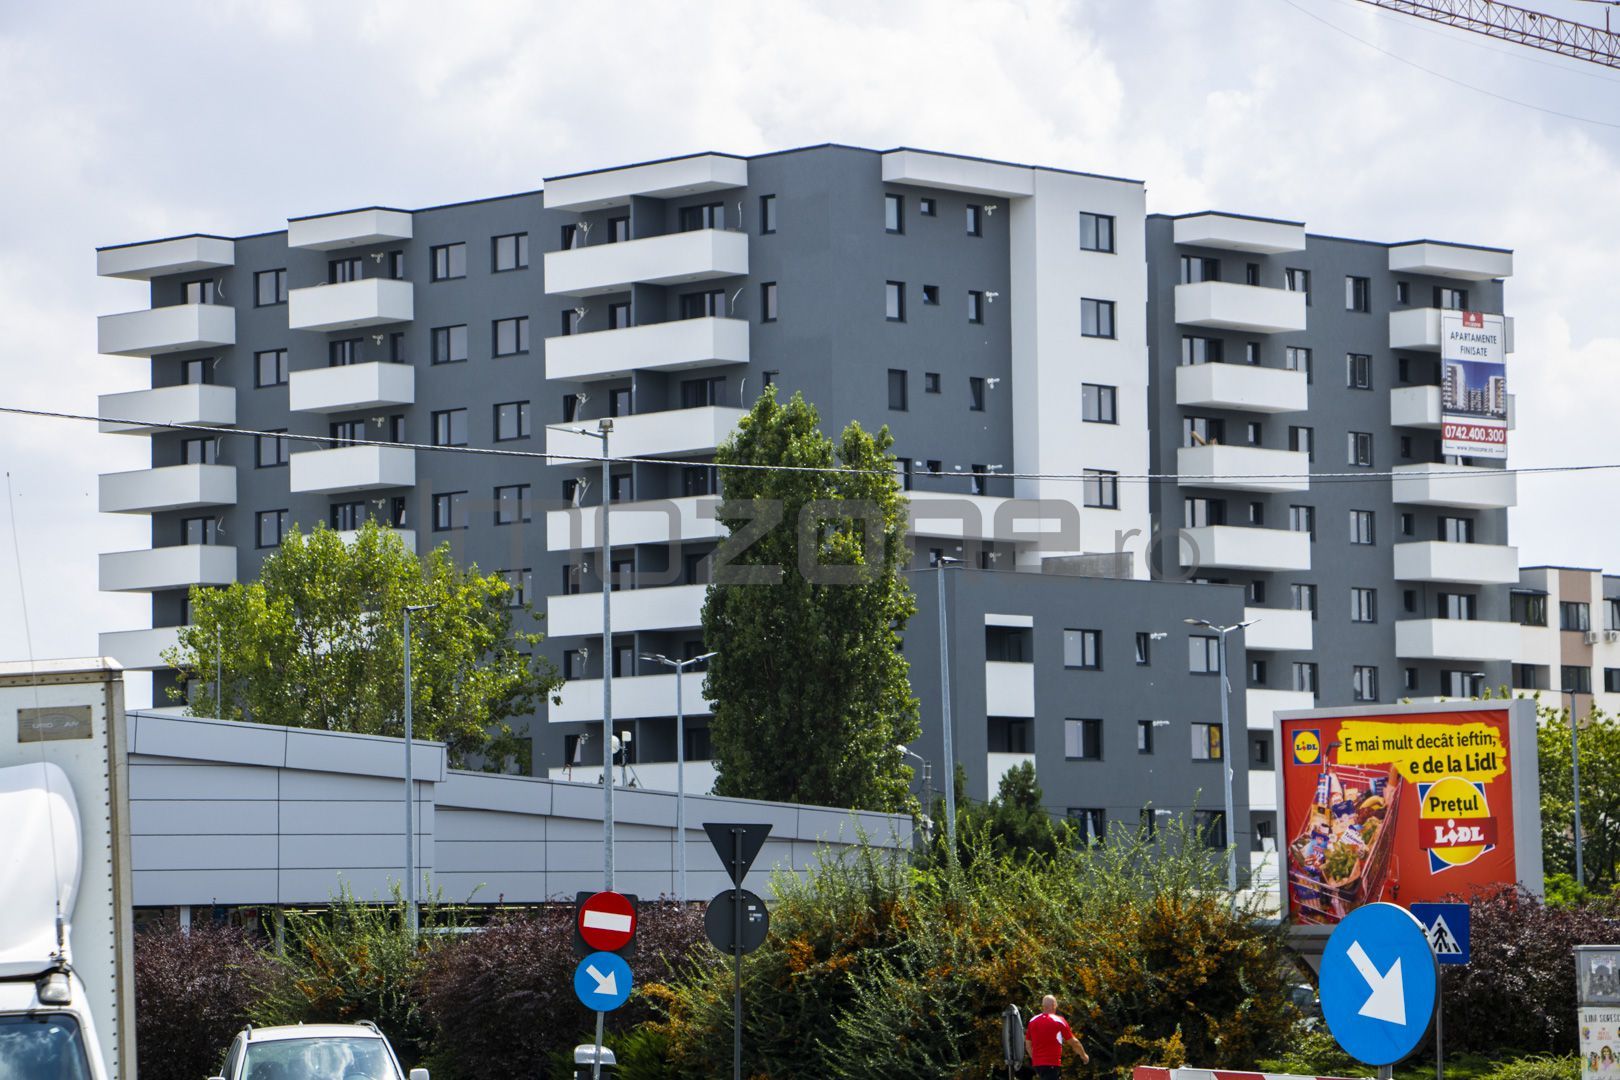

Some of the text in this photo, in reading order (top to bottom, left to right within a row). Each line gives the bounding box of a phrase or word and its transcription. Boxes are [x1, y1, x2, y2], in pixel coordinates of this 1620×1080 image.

[1450, 331, 1497, 345] APARTAMENTE
[1460, 345, 1488, 357] FINISATE
[1445, 424, 1505, 442] 0742.400.300
[1344, 730, 1497, 752] E mai mult decât ieftin,
[1409, 751, 1498, 774] e de la Lidl
[1429, 794, 1479, 816] Prețul
